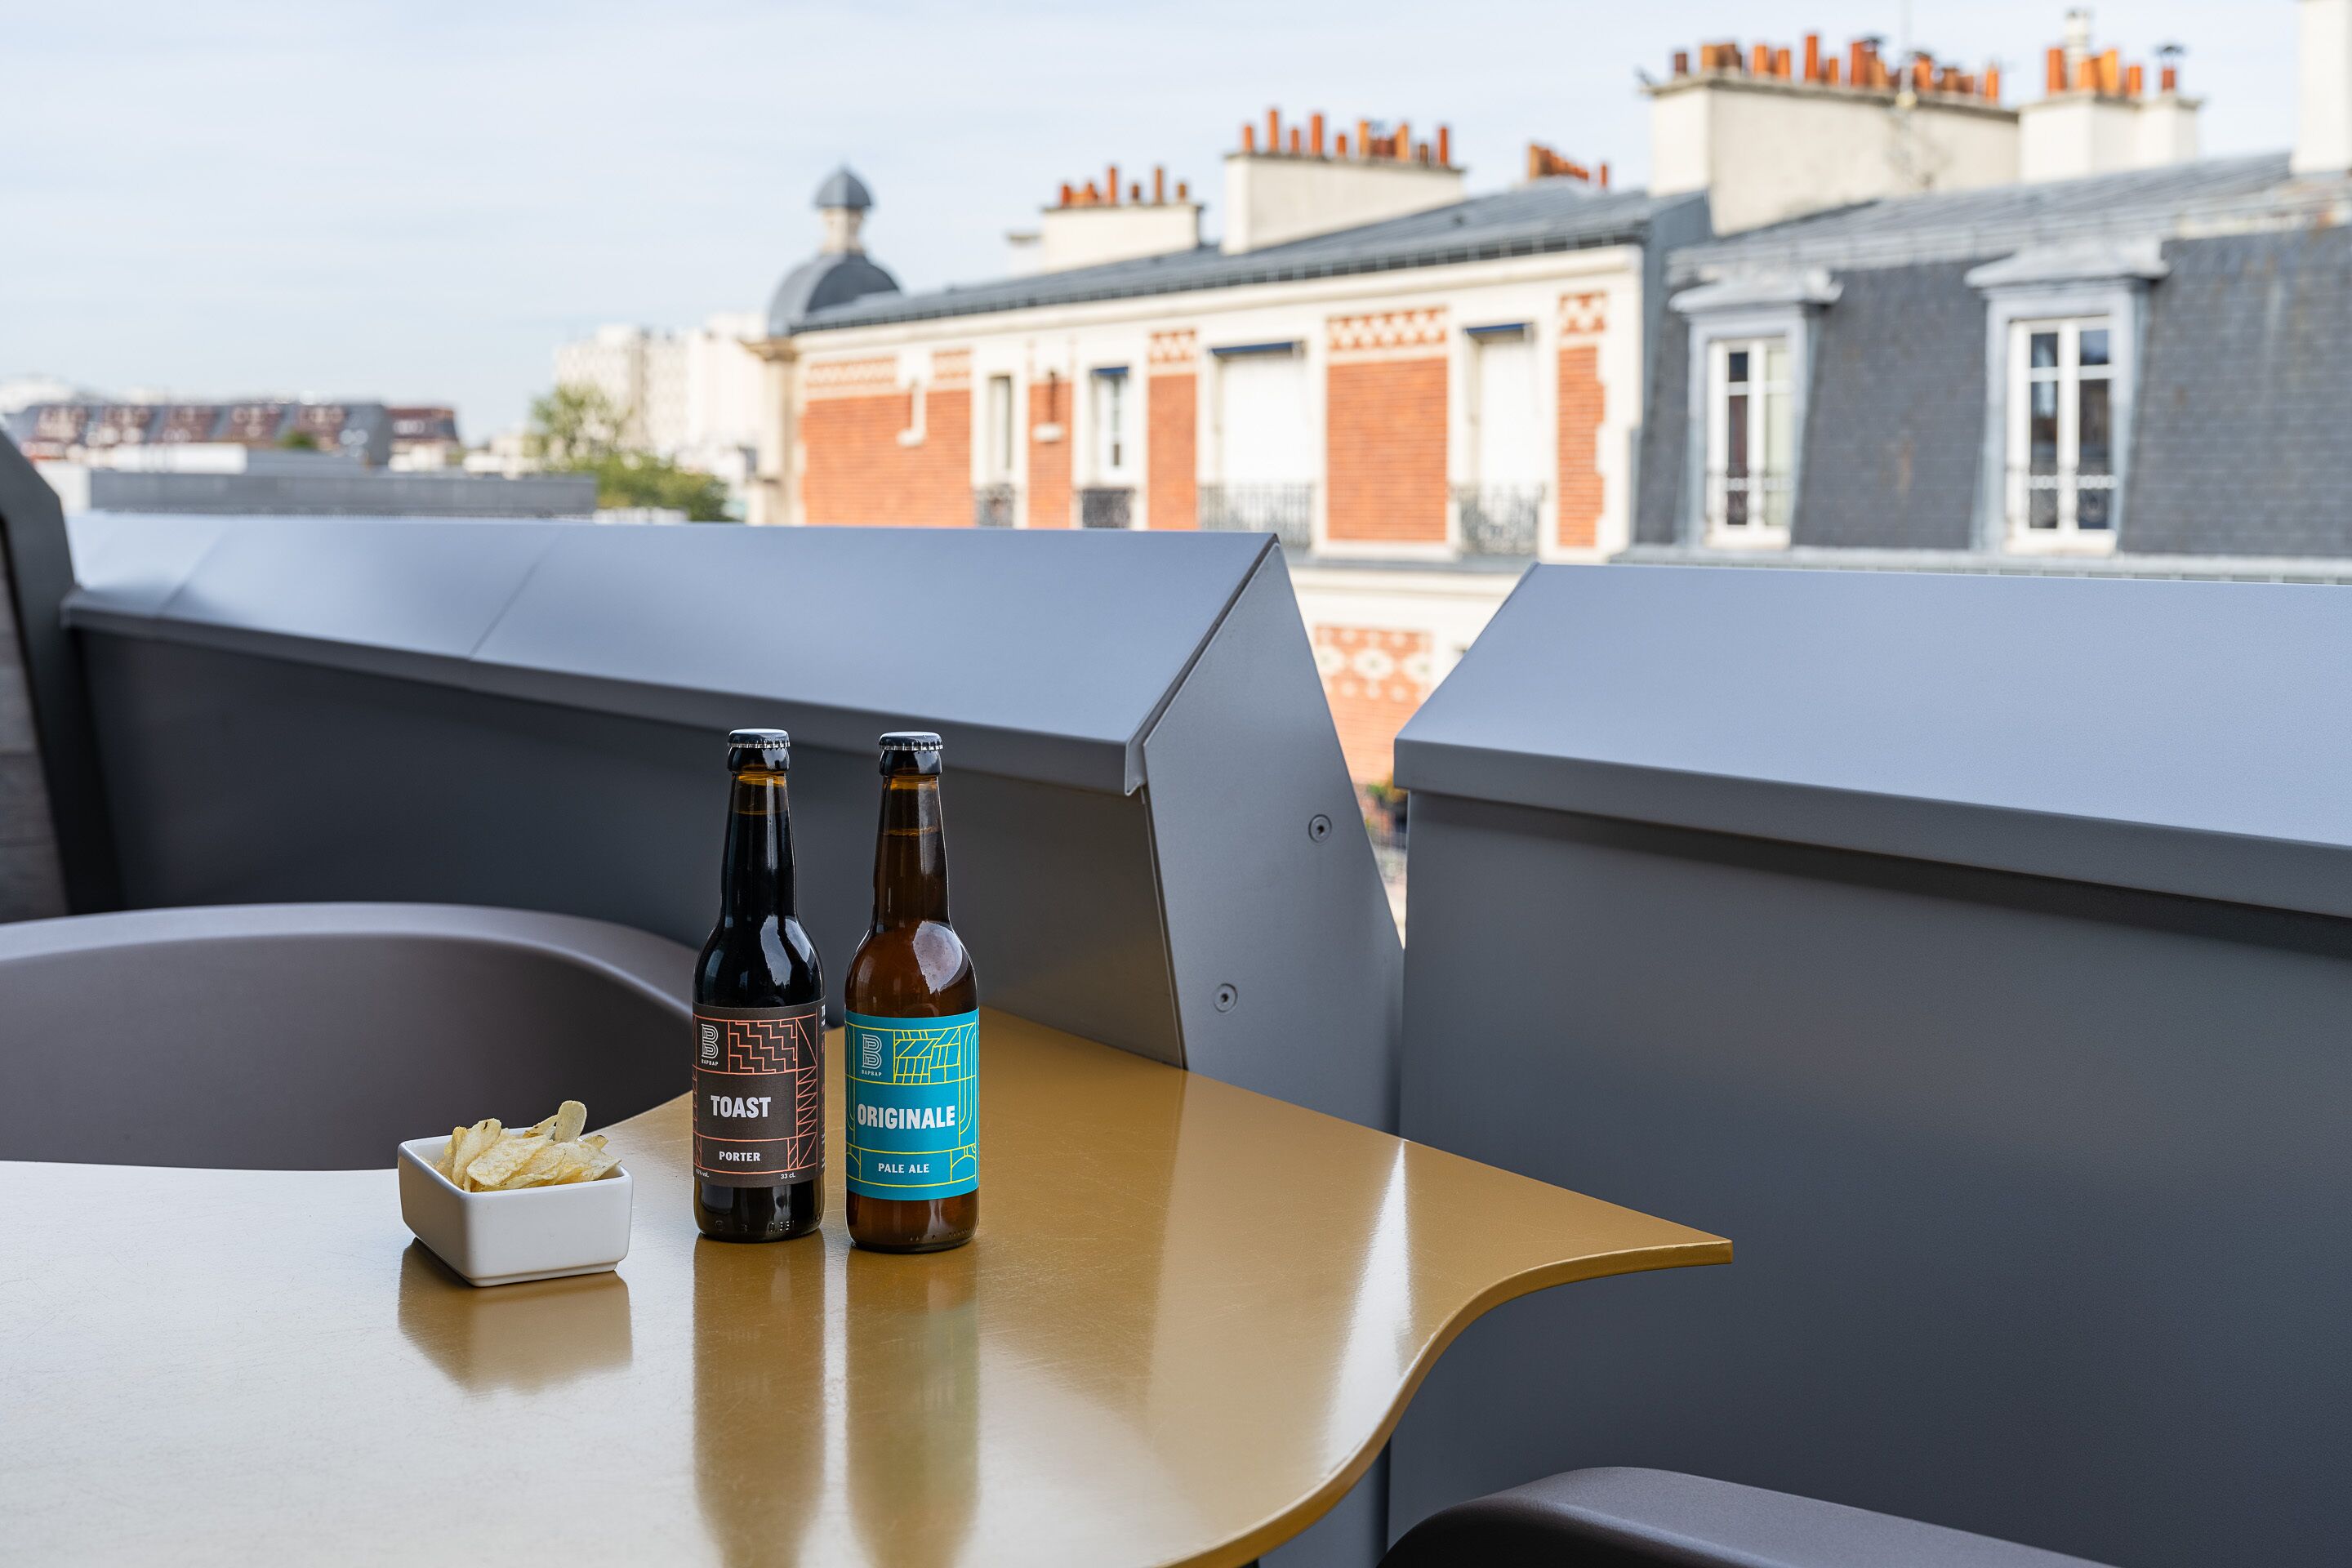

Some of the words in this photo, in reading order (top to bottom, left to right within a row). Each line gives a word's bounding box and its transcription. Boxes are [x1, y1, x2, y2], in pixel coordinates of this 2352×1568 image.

[701, 1023, 719, 1059] B
[862, 1033, 882, 1070] B
[861, 1069, 882, 1077] BAPBAP
[710, 1094, 772, 1119] TOAST
[857, 1103, 956, 1129] ORIGINALE
[719, 1151, 761, 1162] PORTER
[878, 1162, 905, 1174] PALE
[908, 1163, 930, 1174] ALE
